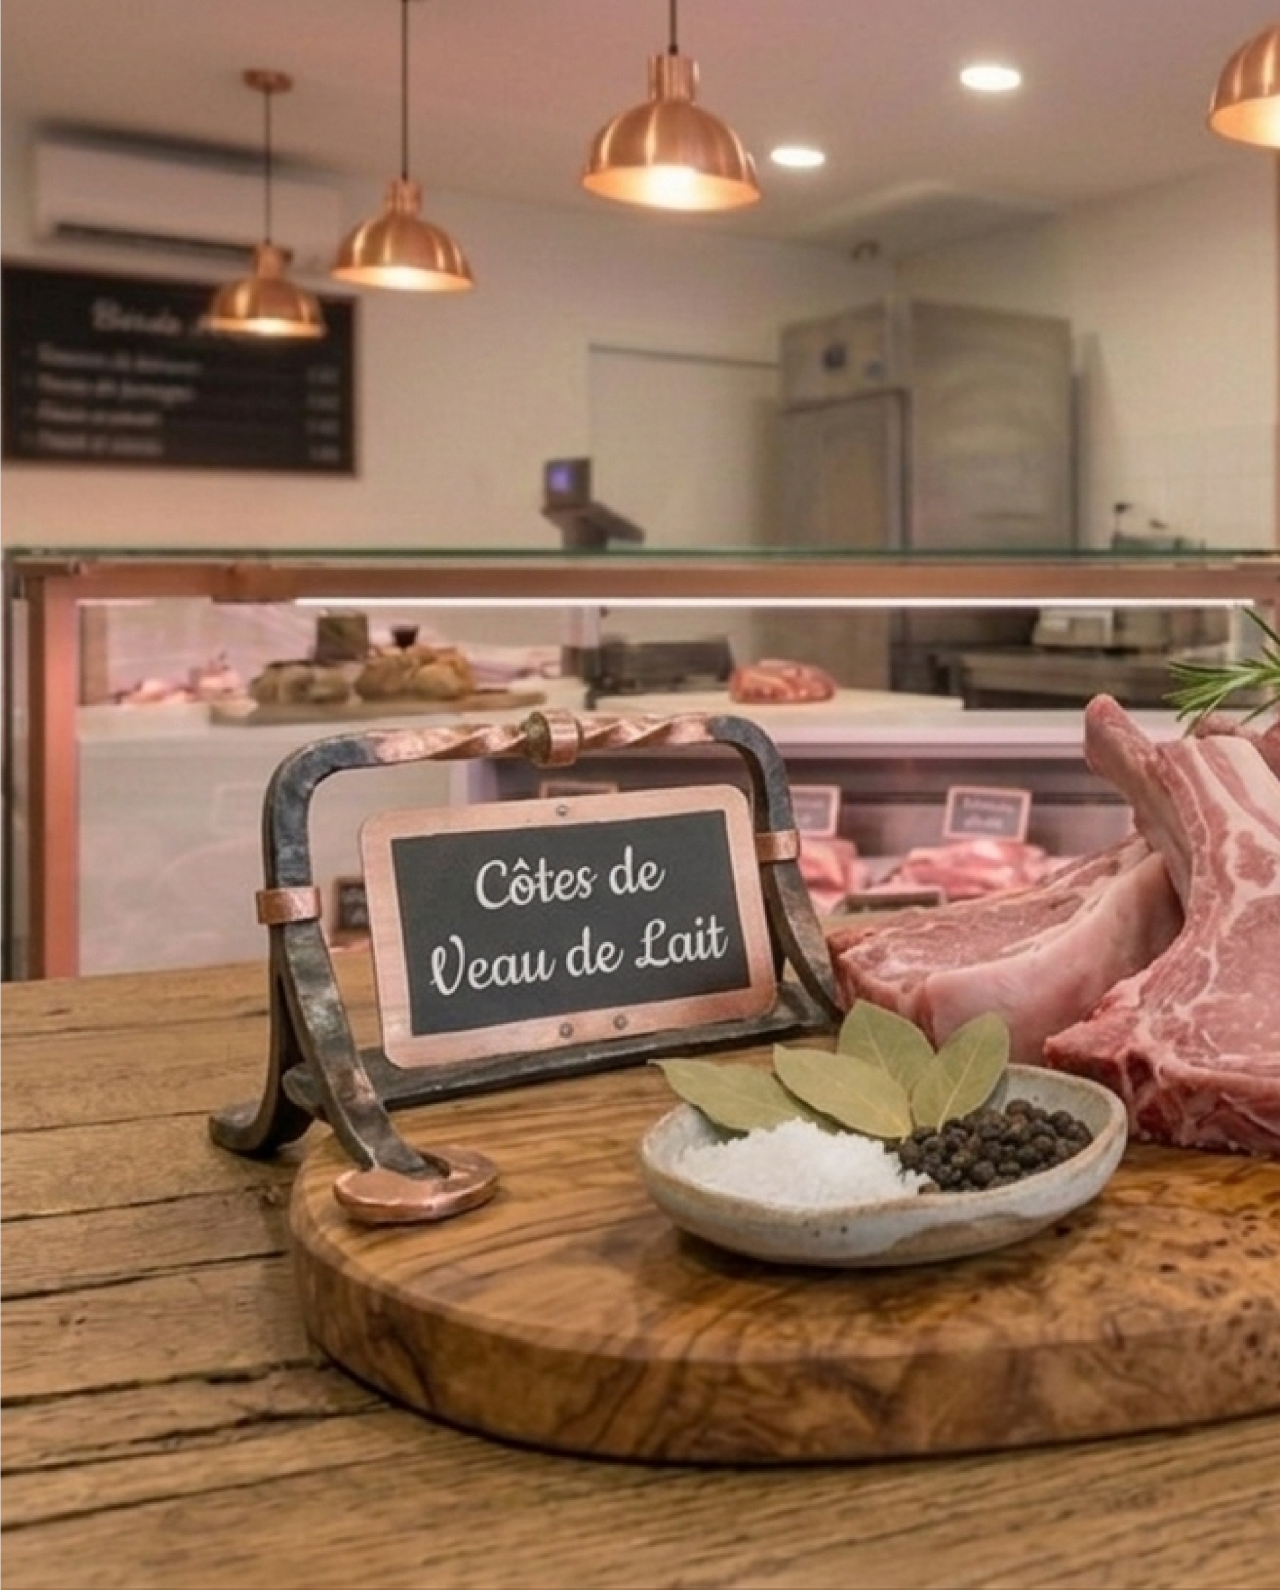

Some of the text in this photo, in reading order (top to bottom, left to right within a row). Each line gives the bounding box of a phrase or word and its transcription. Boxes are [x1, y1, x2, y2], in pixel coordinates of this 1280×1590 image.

[475, 845, 666, 910] Côtes de
[429, 914, 730, 997] Veau de Lait
